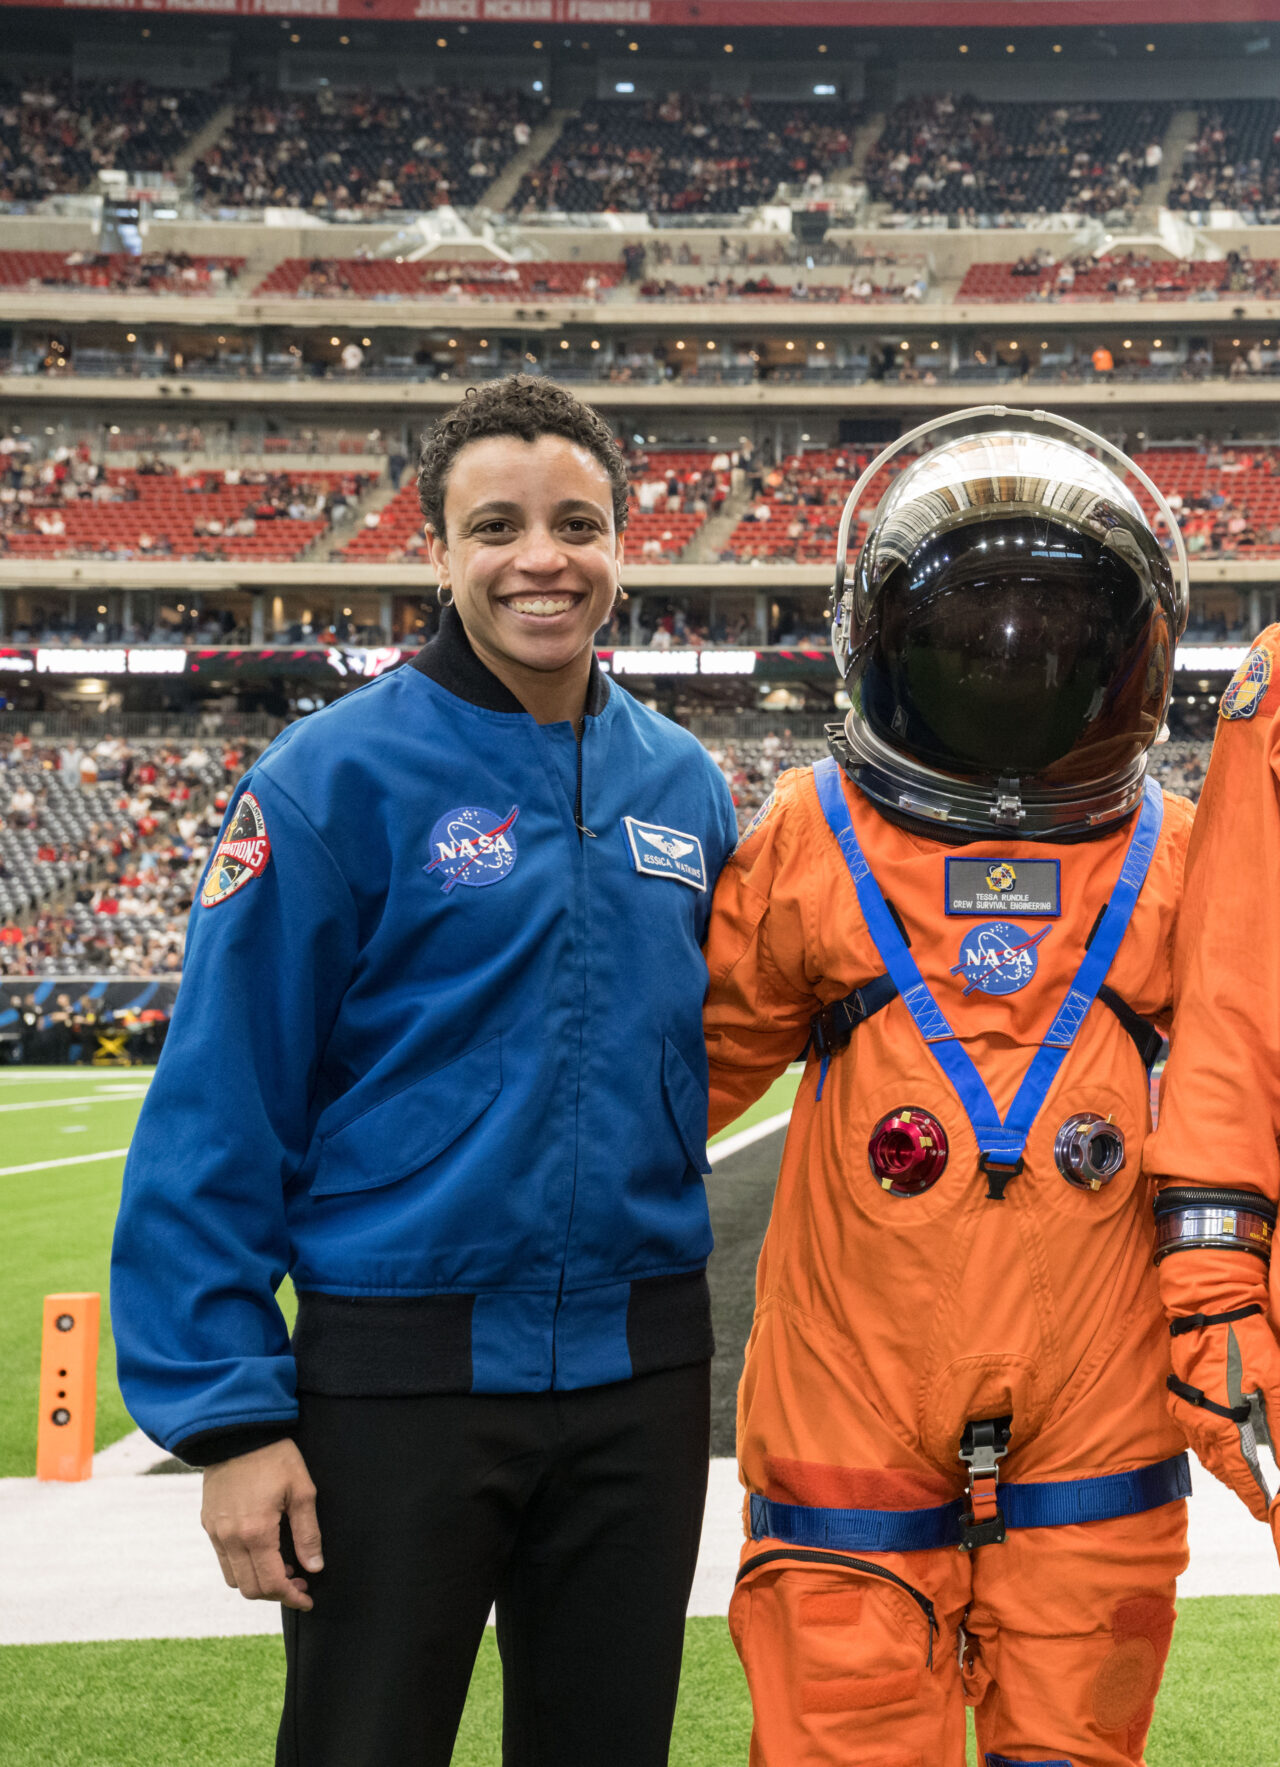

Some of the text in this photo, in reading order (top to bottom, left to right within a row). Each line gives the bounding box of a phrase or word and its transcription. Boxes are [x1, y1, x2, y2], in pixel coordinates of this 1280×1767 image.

[568, 2, 650, 22] FOUNDER
[435, 833, 513, 862] NASA
[643, 853, 673, 869] JESSICA
[953, 900, 1052, 911] CREW SURVIVAL ENGINEERING
[975, 893, 1030, 902] TESSA RUNDLE
[965, 948, 1034, 967] NASA
